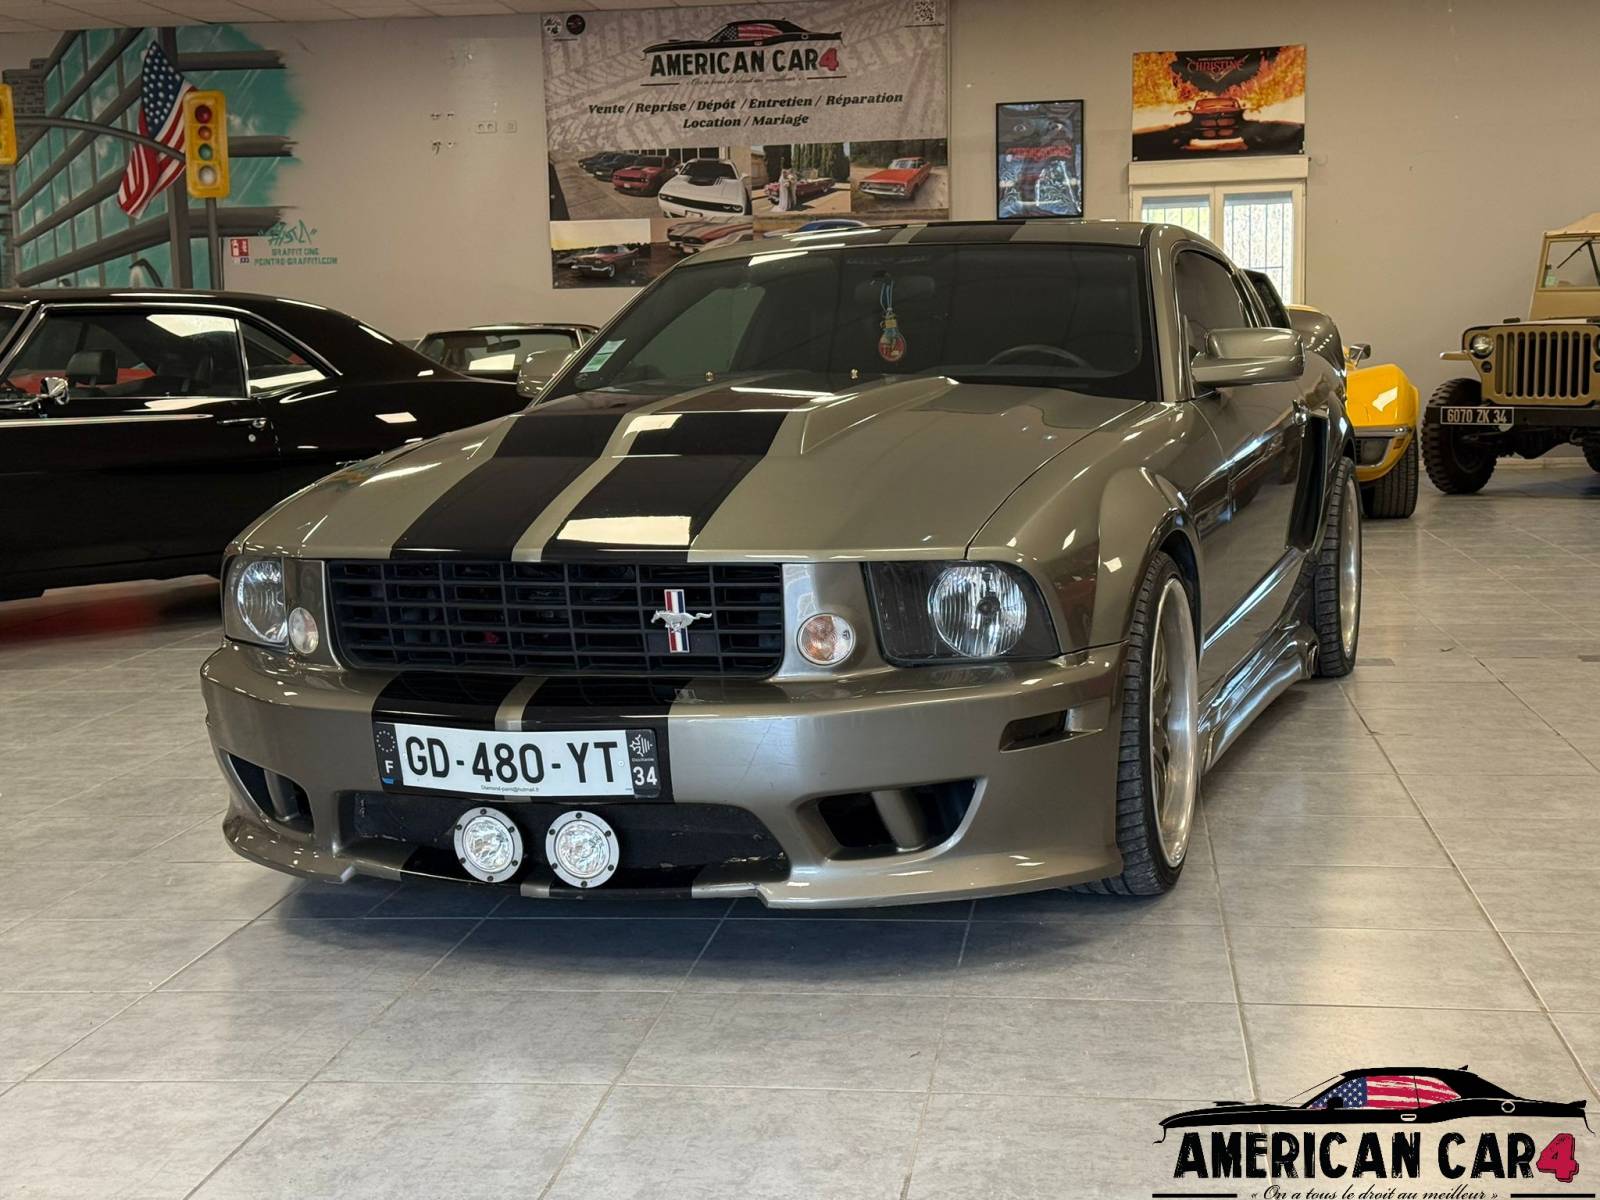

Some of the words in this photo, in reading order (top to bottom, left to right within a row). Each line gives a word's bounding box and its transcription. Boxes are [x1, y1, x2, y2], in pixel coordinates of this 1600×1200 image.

[650, 51, 765, 77] AMERICAN
[772, 47, 840, 72] CAR4
[588, 104, 625, 114] Vente
[635, 101, 687, 114] Reprise
[749, 96, 813, 109] Entretien
[825, 92, 904, 107] Réparation
[683, 116, 741, 129] Location
[751, 113, 809, 127] Mariage
[1447, 408, 1473, 424] 6070
[1476, 408, 1490, 424] ZK
[1493, 409, 1508, 424] 34
[384, 759, 394, 774] F
[405, 735, 618, 784] GD-480-YT
[633, 766, 658, 786] 34
